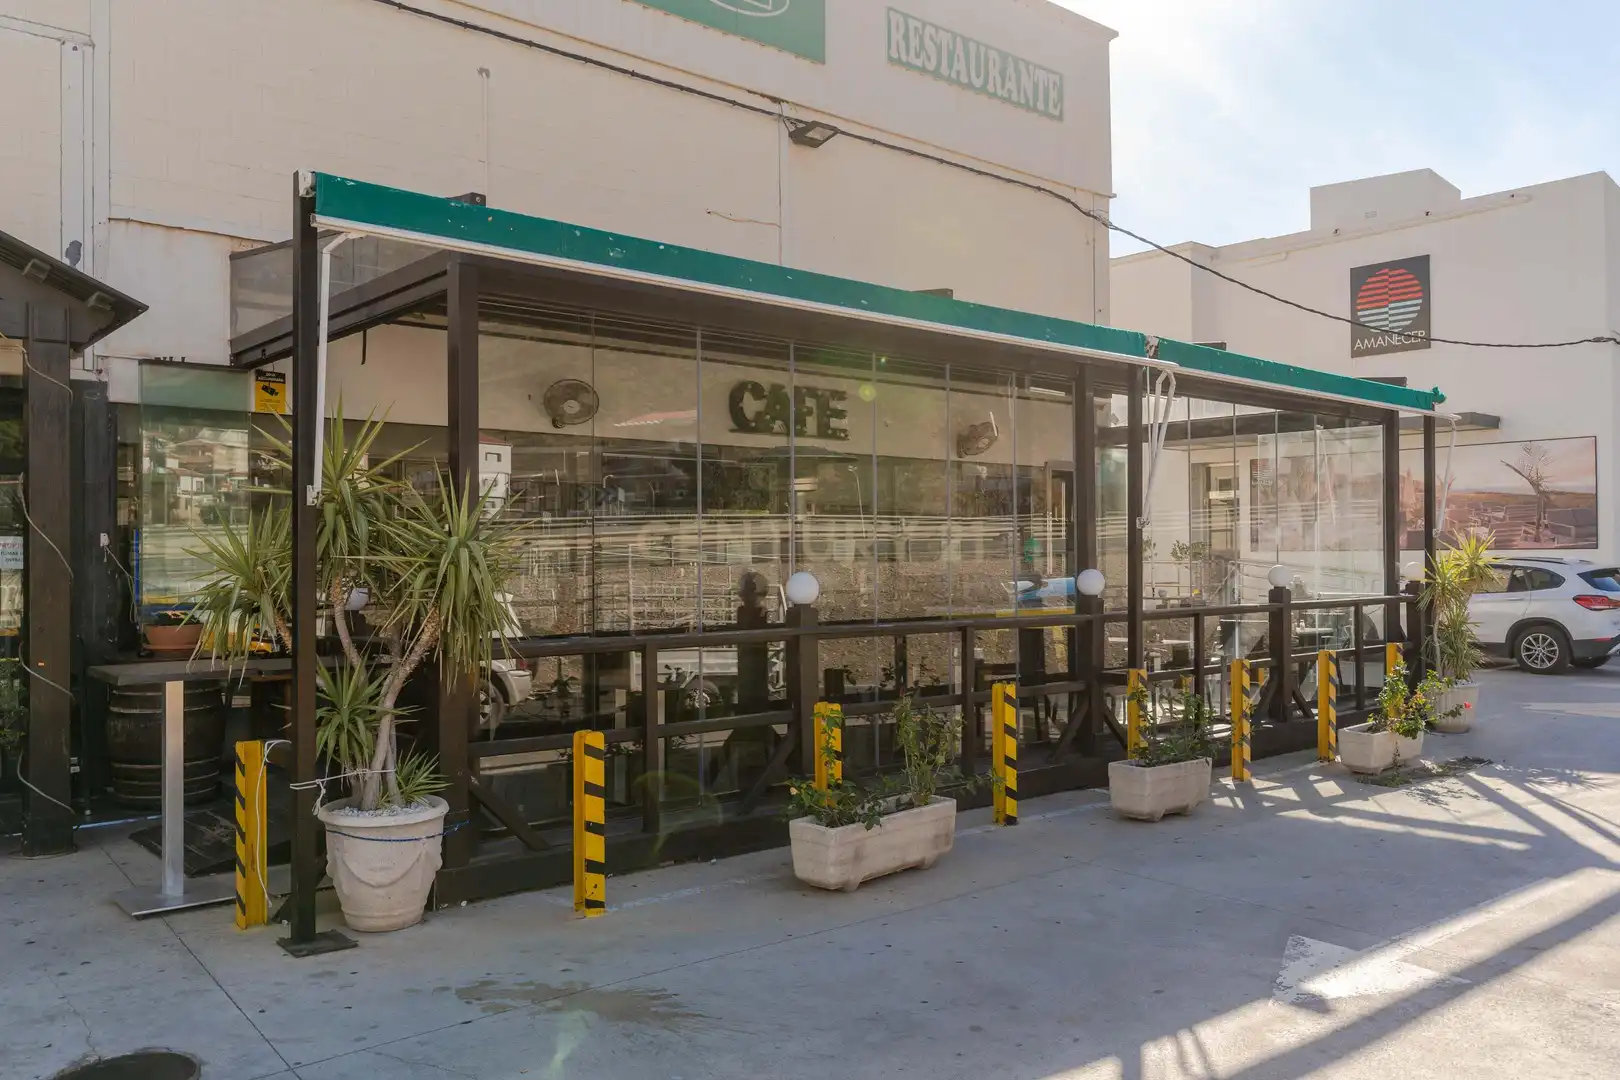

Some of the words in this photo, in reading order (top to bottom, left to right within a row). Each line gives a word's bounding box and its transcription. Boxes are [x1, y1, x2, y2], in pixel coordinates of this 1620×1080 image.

[889, 10, 1061, 116] RESTAURANTE
[1354, 330, 1426, 350] AMANECER
[729, 381, 849, 440] CAFE
